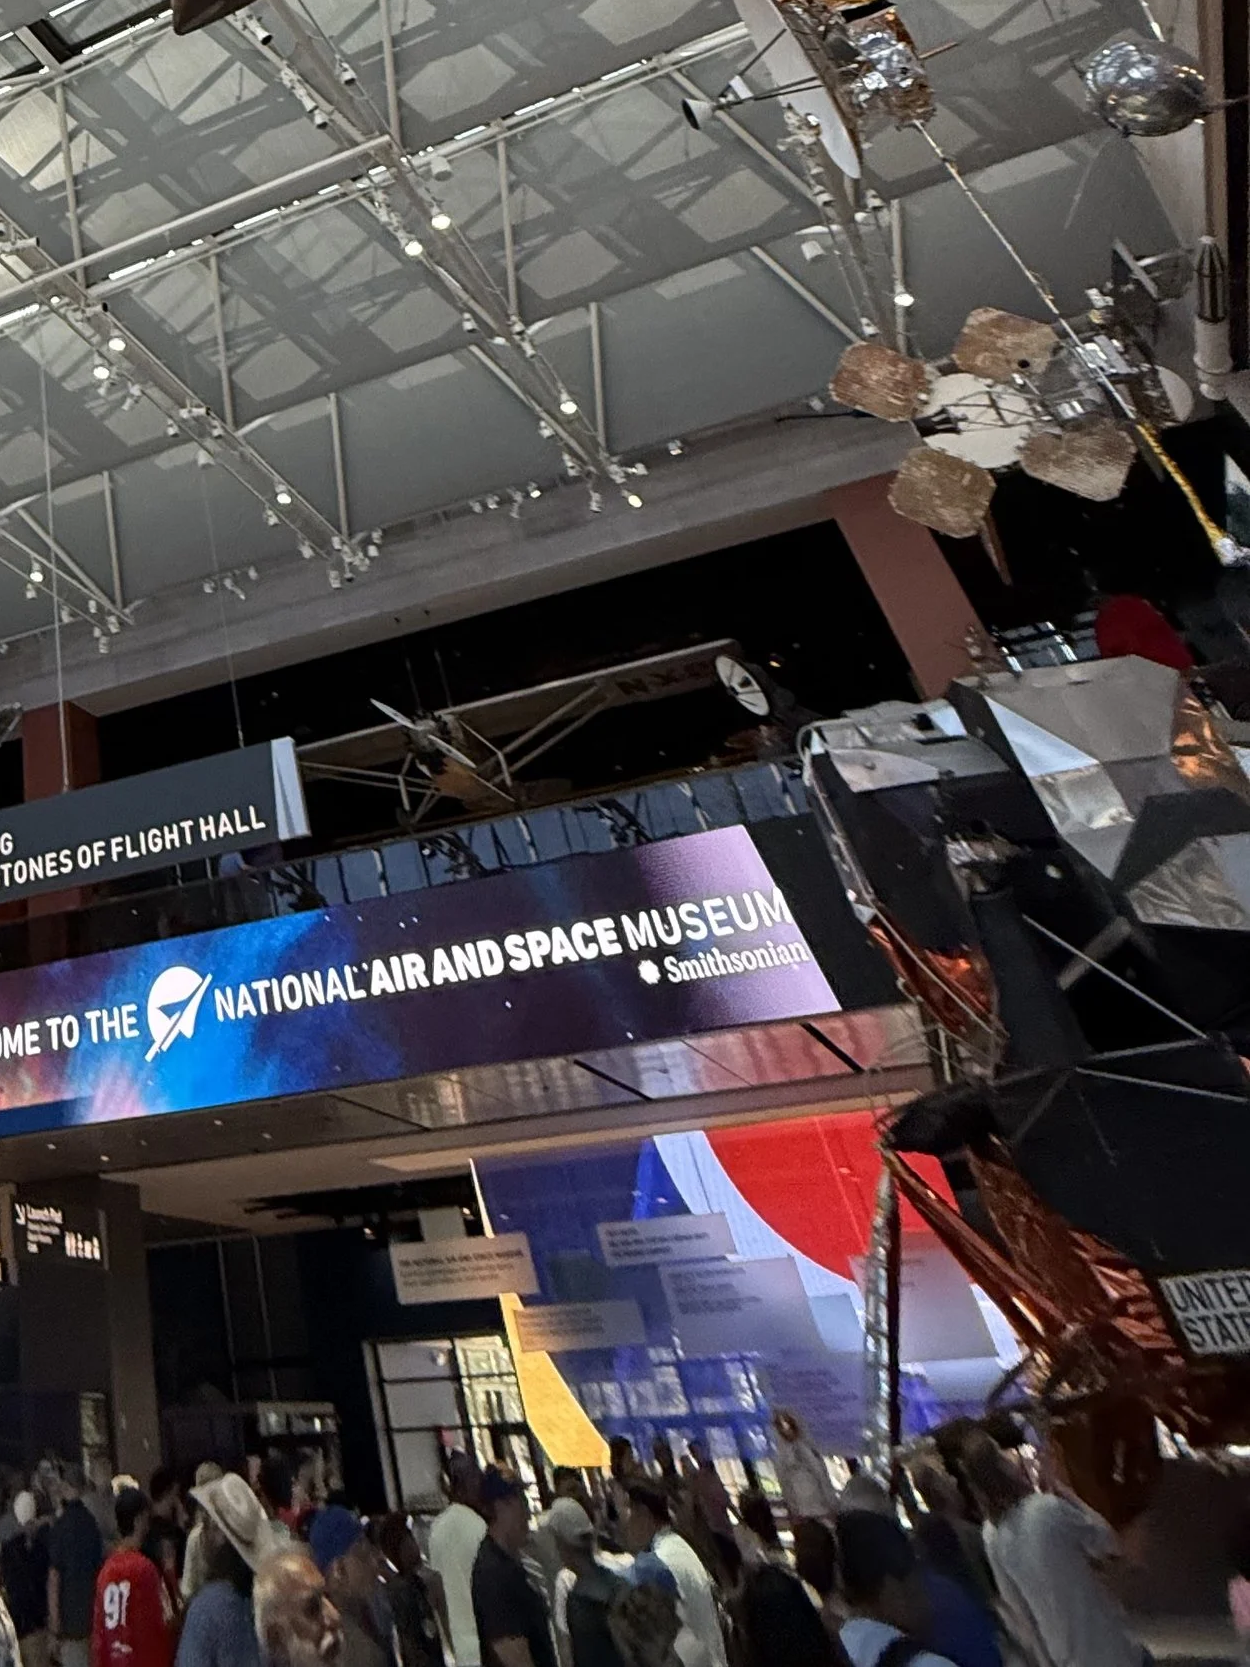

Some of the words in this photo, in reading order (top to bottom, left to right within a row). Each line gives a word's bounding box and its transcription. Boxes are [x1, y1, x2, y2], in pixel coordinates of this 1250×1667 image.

[77, 841, 106, 870] OF
[110, 819, 194, 863] FLIGHT
[199, 804, 266, 842] HALL
[46, 1014, 80, 1051] TO
[84, 1003, 140, 1044] THE
[214, 964, 367, 1023] NATIONAL
[370, 952, 430, 996] AIR
[432, 939, 504, 985] AND
[504, 917, 623, 972] SPACE
[621, 886, 793, 951] MUSEUM
[664, 939, 810, 984] Smithsonian
